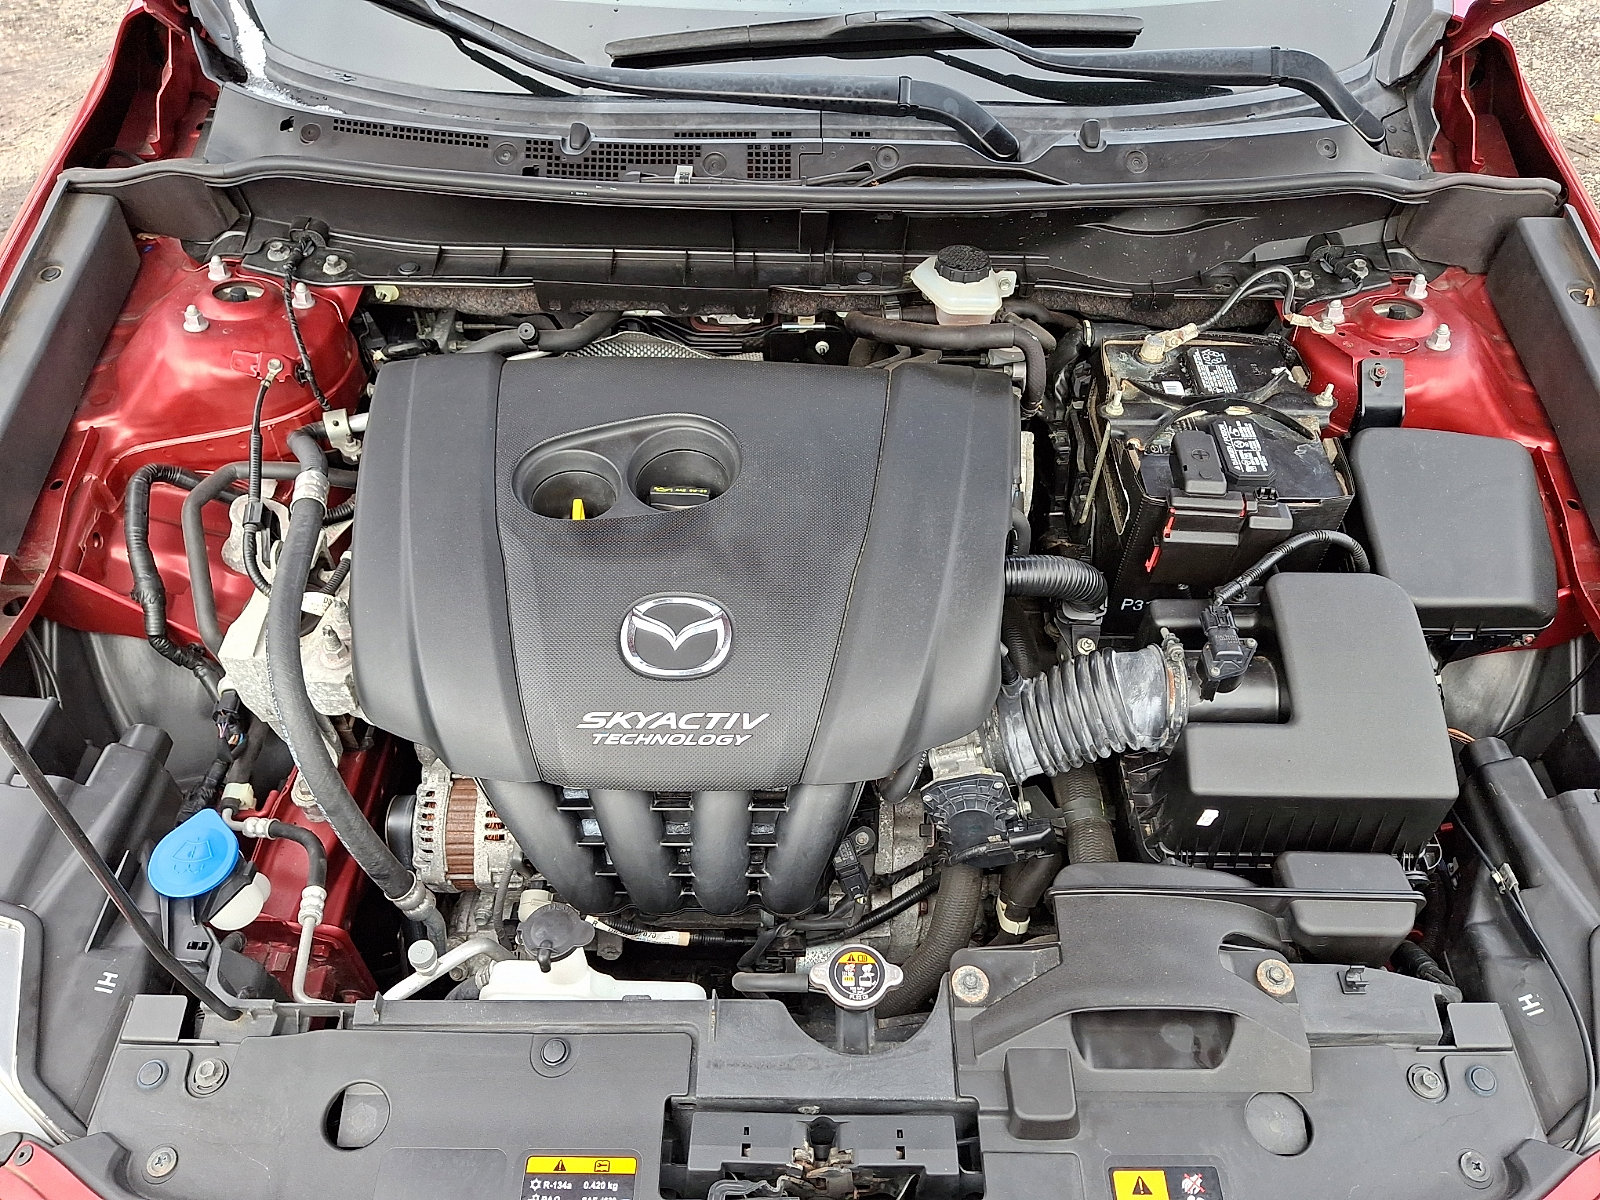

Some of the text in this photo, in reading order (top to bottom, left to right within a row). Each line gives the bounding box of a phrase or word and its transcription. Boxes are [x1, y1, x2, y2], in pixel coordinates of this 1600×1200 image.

[575, 711, 771, 730] SKYACTIV
[592, 732, 753, 746] TECHNOLOGY
[542, 1180, 619, 1192] R-134a 0.420 kg
